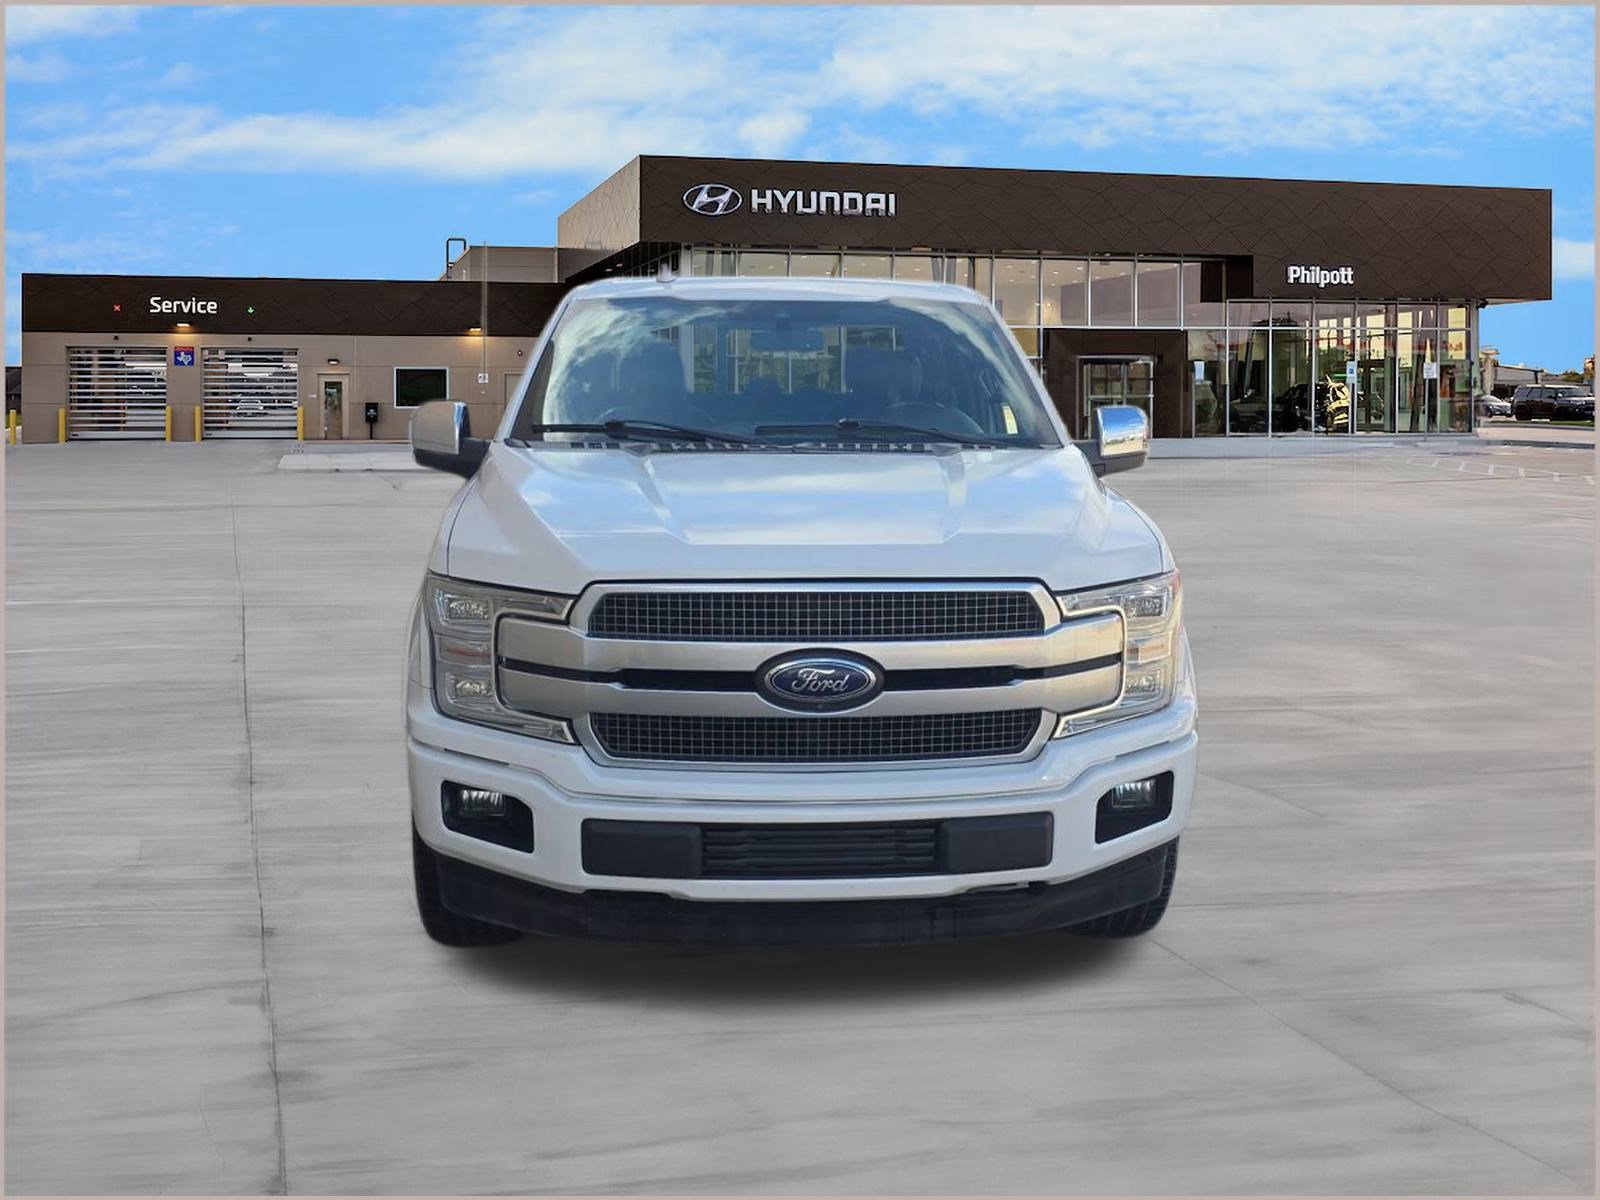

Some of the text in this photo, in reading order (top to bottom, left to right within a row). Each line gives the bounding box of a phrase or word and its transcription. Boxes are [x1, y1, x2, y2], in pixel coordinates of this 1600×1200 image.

[750, 188, 897, 217] HYUNDAI
[1287, 265, 1354, 288] Philpott
[149, 296, 218, 315] Service
[791, 667, 850, 692] Ford
